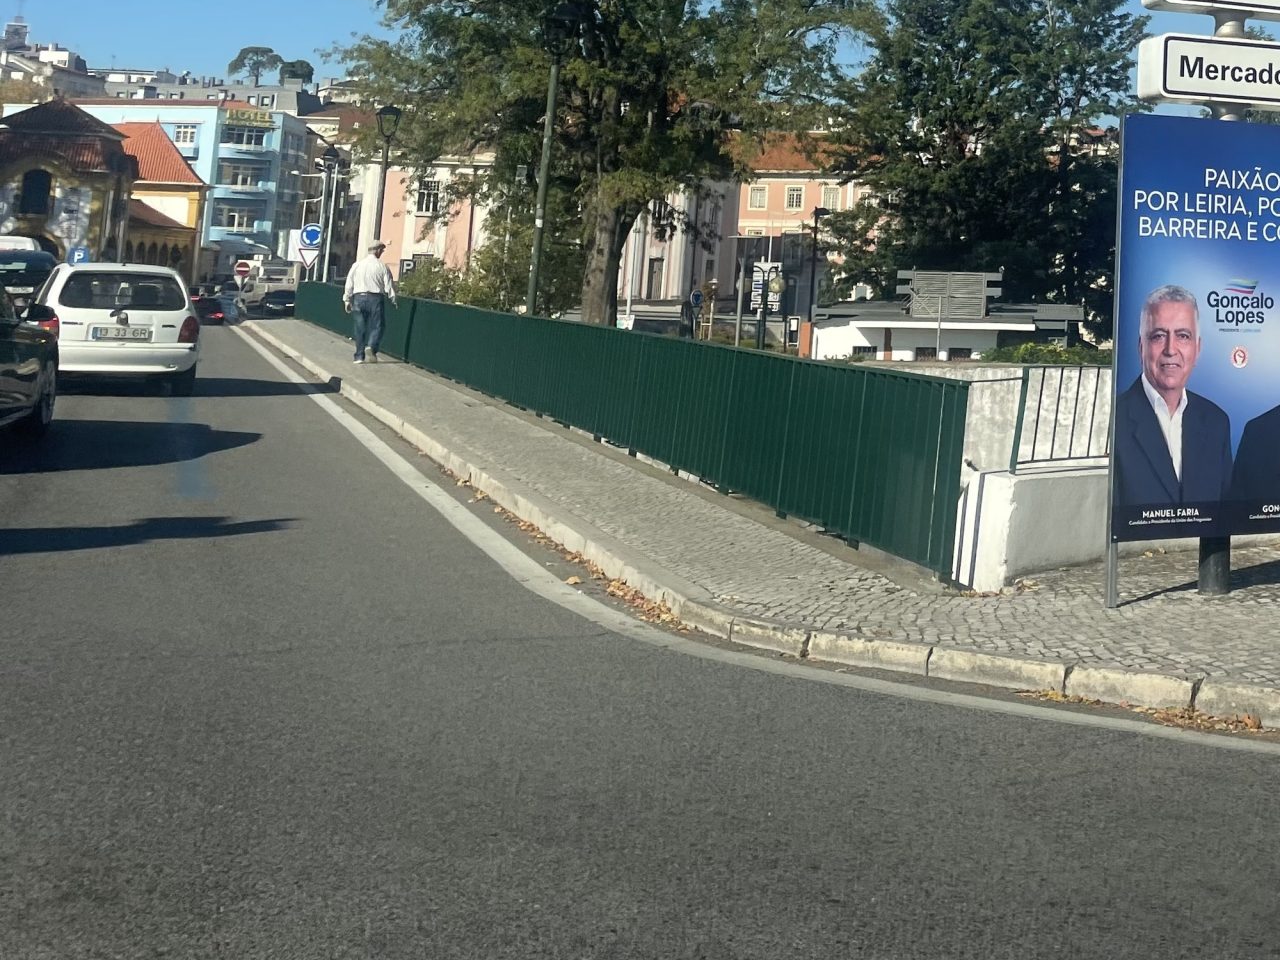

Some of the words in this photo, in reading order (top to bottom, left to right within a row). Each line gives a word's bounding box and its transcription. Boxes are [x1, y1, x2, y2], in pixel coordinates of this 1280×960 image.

[1205, 166, 1280, 192] PAIXÃO
[1134, 190, 1179, 212] POR
[1184, 193, 1253, 218] LEIRIA,
[1138, 216, 1241, 240] BARREIRA
[1247, 222, 1258, 241] E
[73, 252, 84, 263] P
[402, 261, 414, 272] P
[1206, 290, 1275, 310] Gonçalo
[1215, 308, 1265, 326] Lopes
[1142, 509, 1176, 519] MANUEL
[1176, 507, 1200, 517] FARIA
